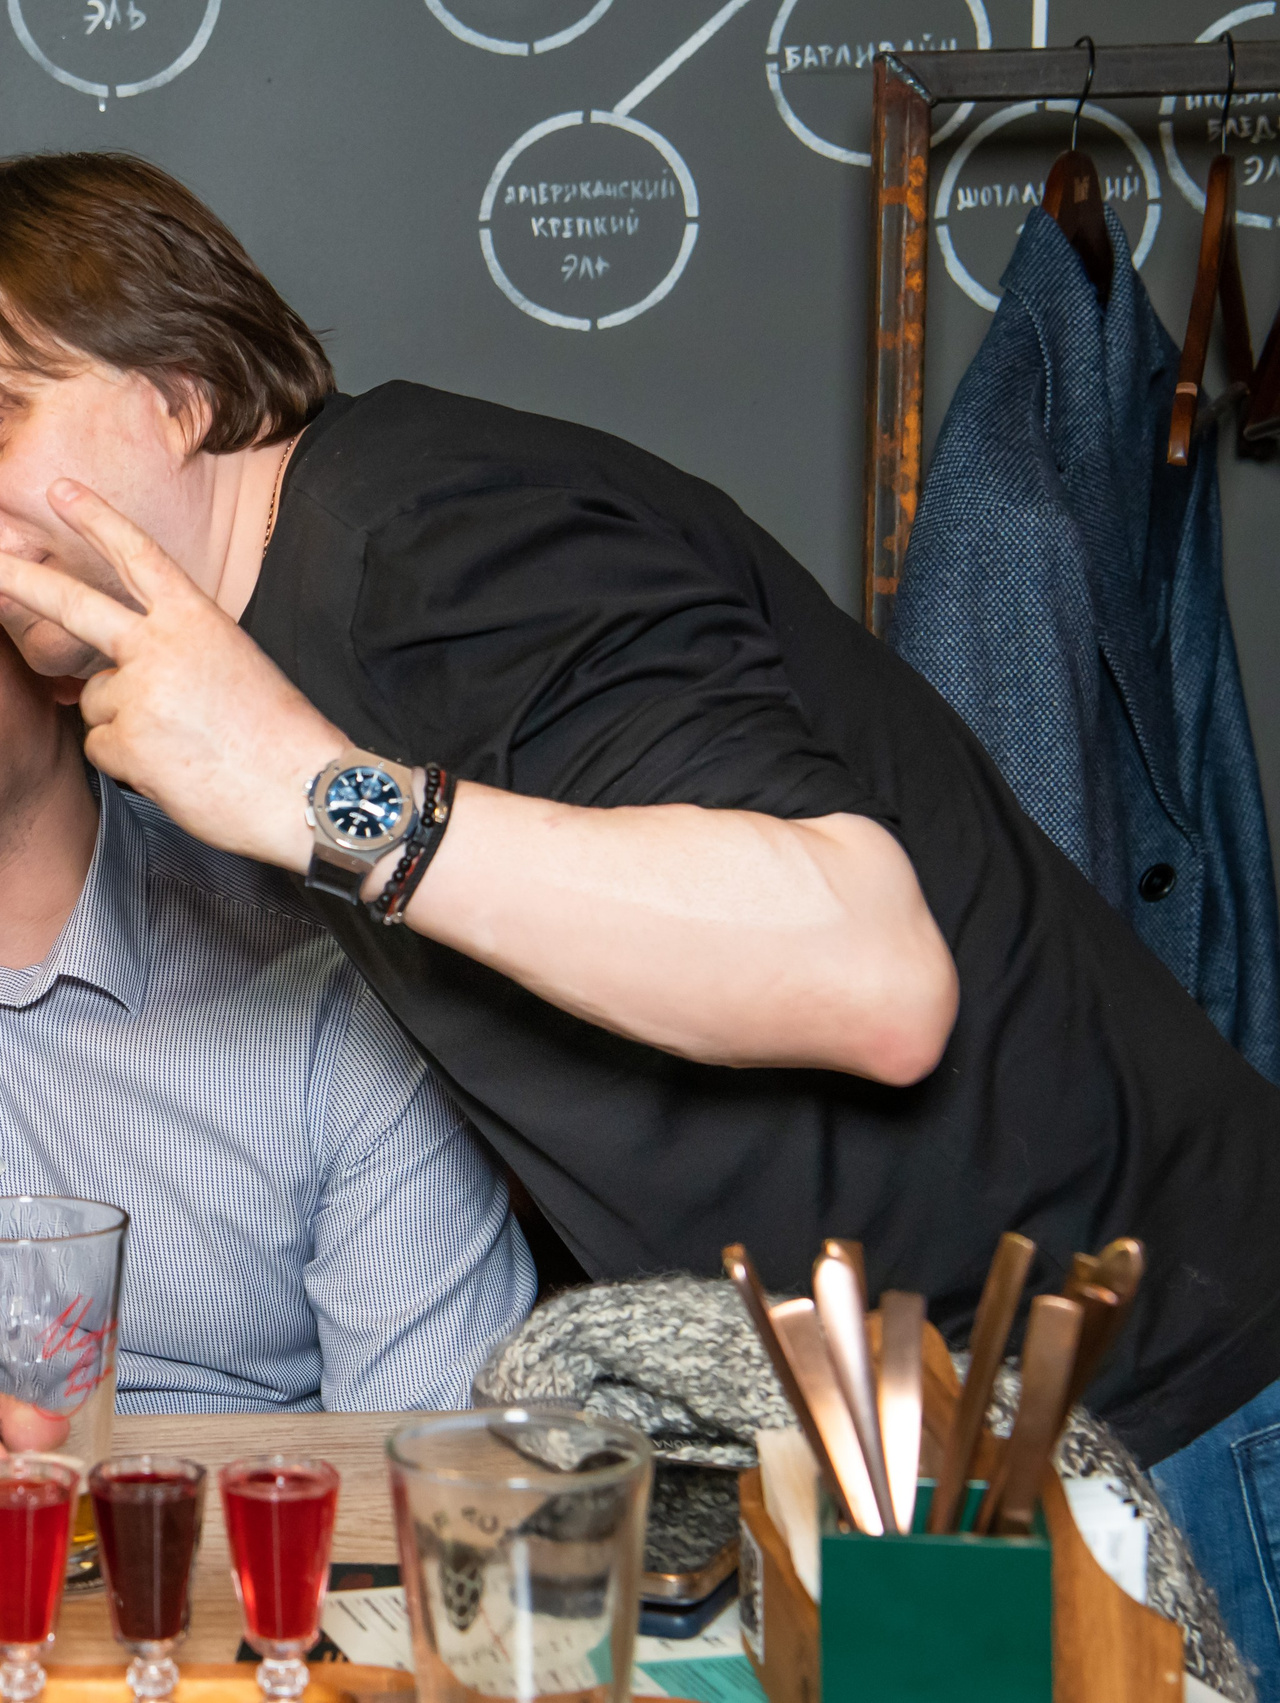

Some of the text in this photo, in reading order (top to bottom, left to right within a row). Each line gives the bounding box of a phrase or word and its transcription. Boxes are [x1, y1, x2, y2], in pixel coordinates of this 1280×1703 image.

[504, 168, 676, 206] АМЕРИКАНСКИЙ
[956, 164, 1141, 212] ШОТЛАИЙ
[531, 207, 640, 239] КРЕПКИЙ
